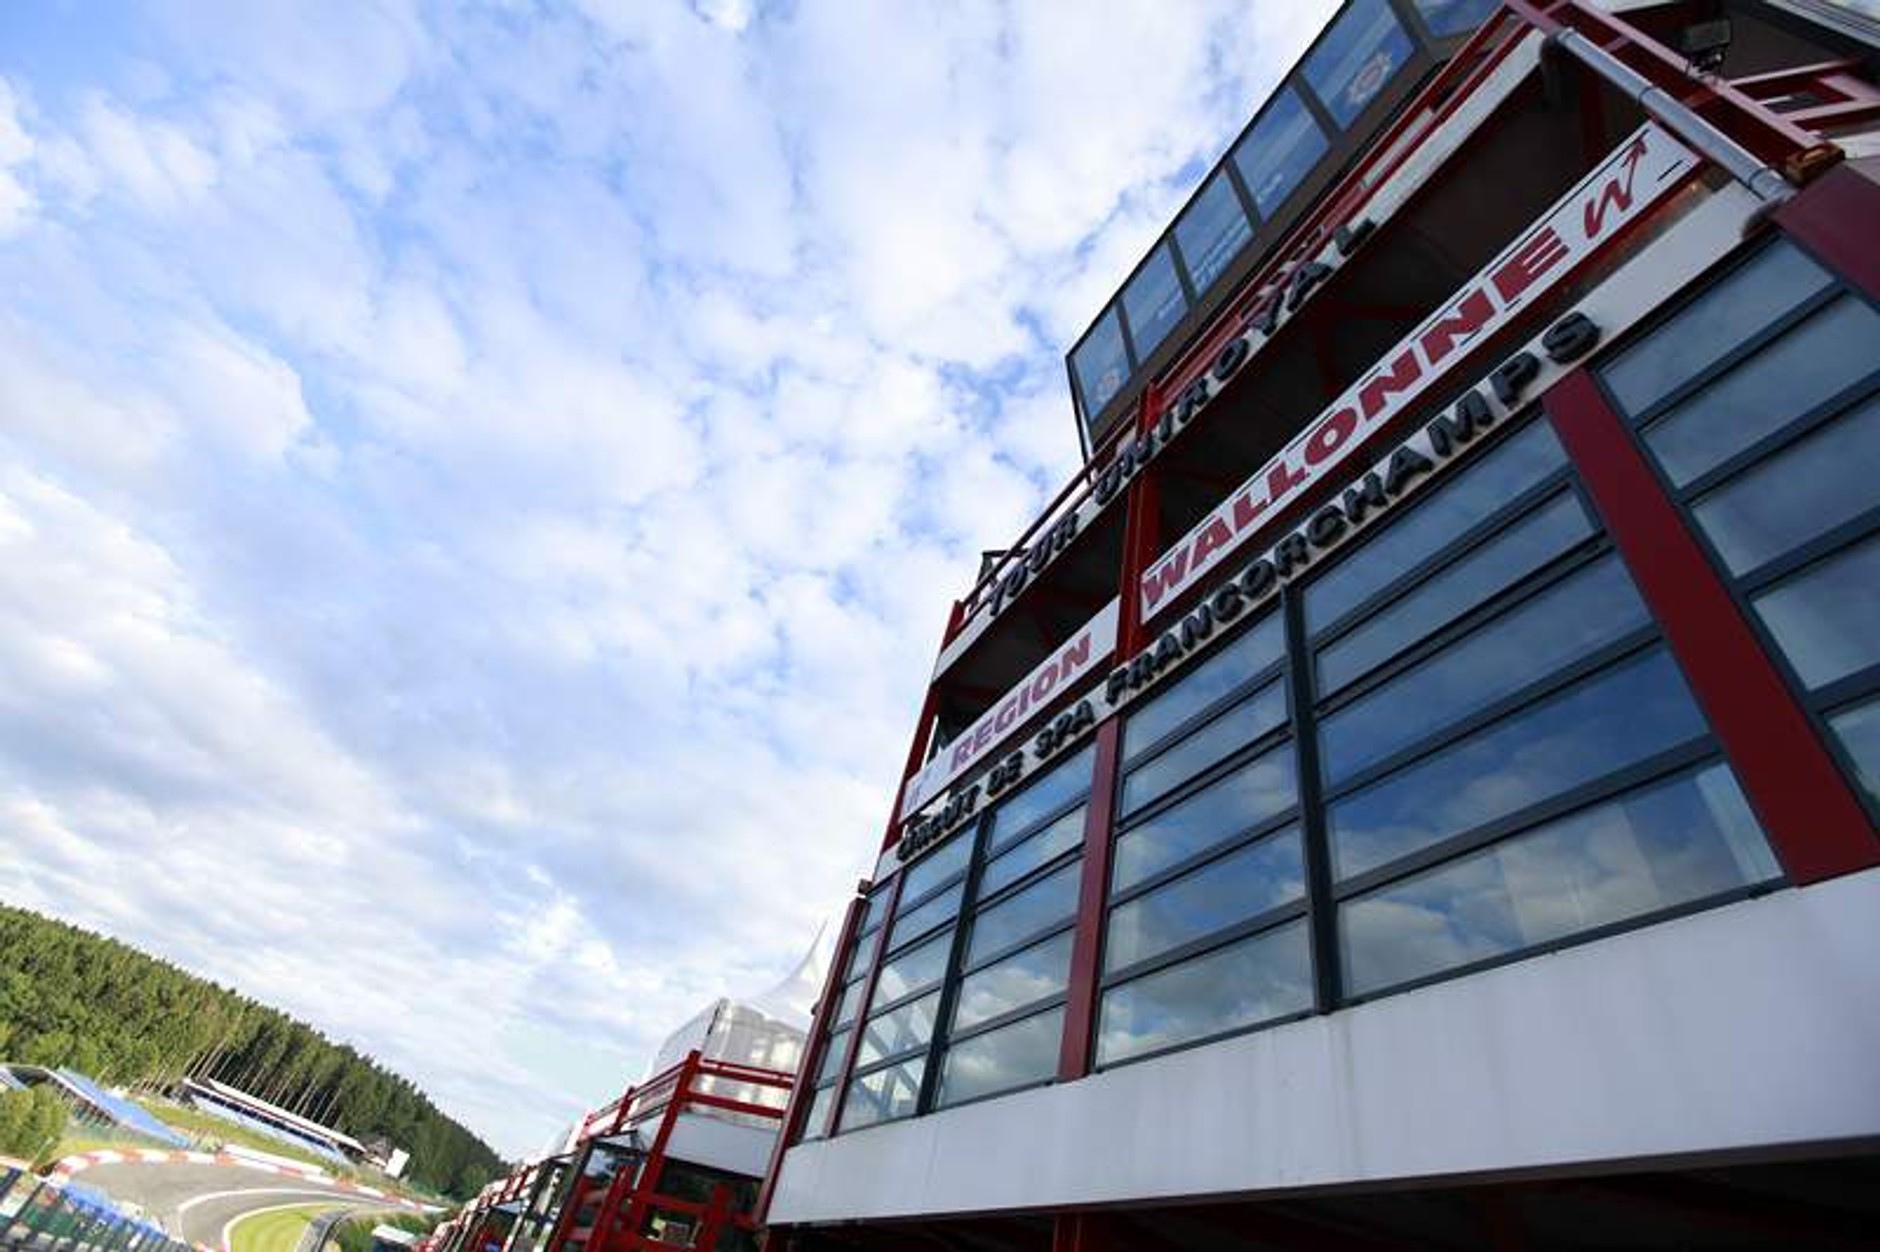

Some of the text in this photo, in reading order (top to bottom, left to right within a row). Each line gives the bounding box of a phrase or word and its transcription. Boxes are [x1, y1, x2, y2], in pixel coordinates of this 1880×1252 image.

[950, 632, 1092, 770] REGION
[1141, 226, 1572, 601] WALLONNE
[983, 216, 1378, 617] TOUR UNIROYAL
[987, 748, 1024, 797] DE
[1034, 700, 1095, 760] SPA
[1105, 311, 1602, 707] FRANCORCHAMPS
